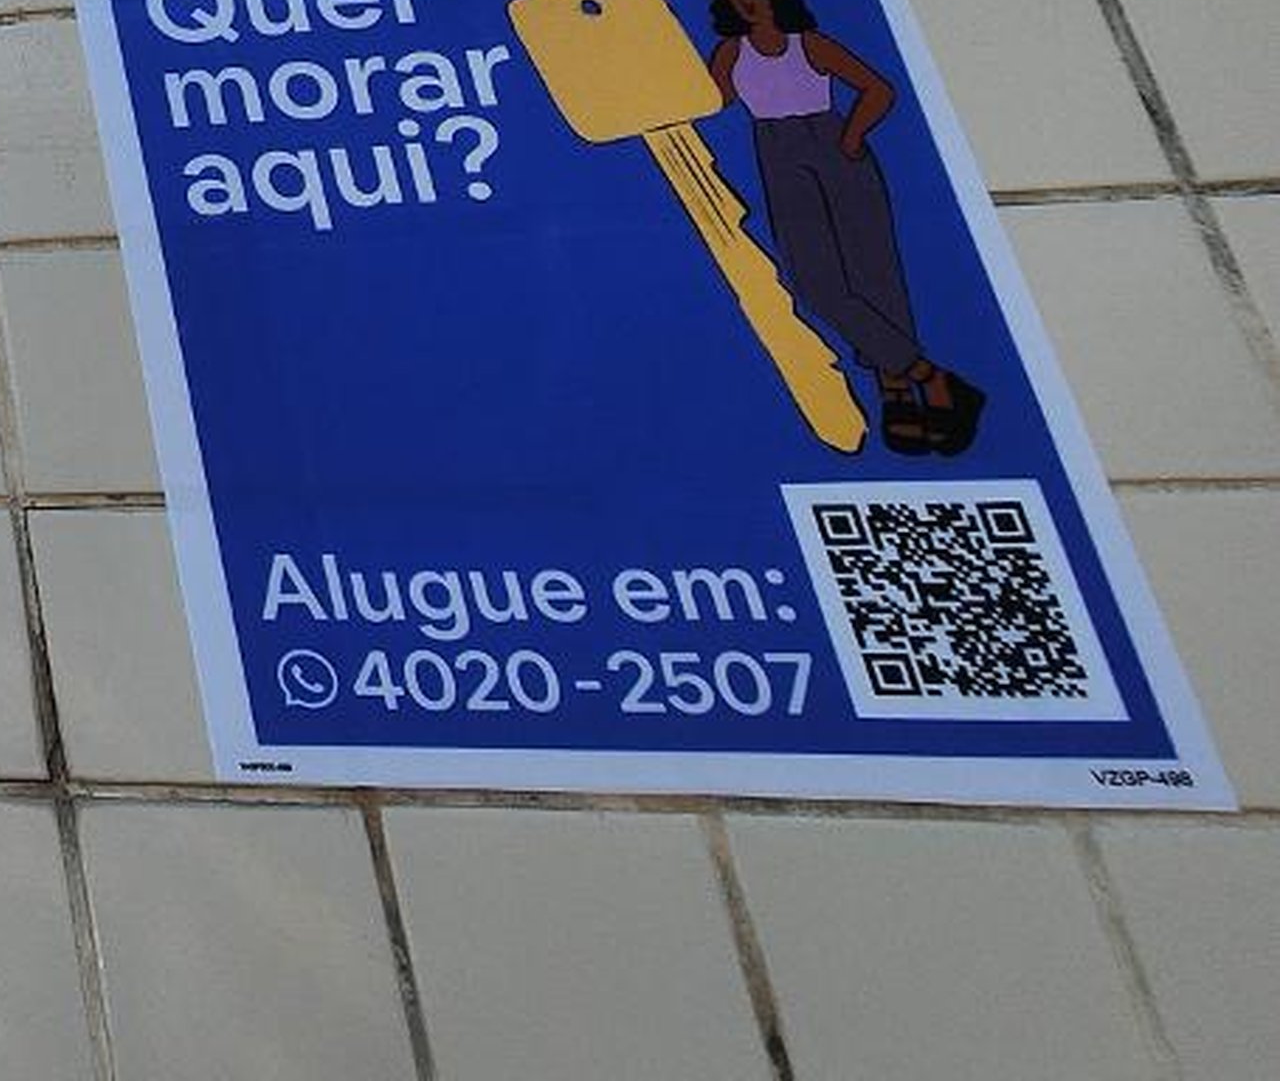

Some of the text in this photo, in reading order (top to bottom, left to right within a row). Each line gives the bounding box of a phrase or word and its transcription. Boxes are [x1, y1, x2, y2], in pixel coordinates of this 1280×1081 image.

[162, 41, 513, 128] morar
[182, 117, 500, 231] aqui?
[262, 553, 797, 643] Alugue em:
